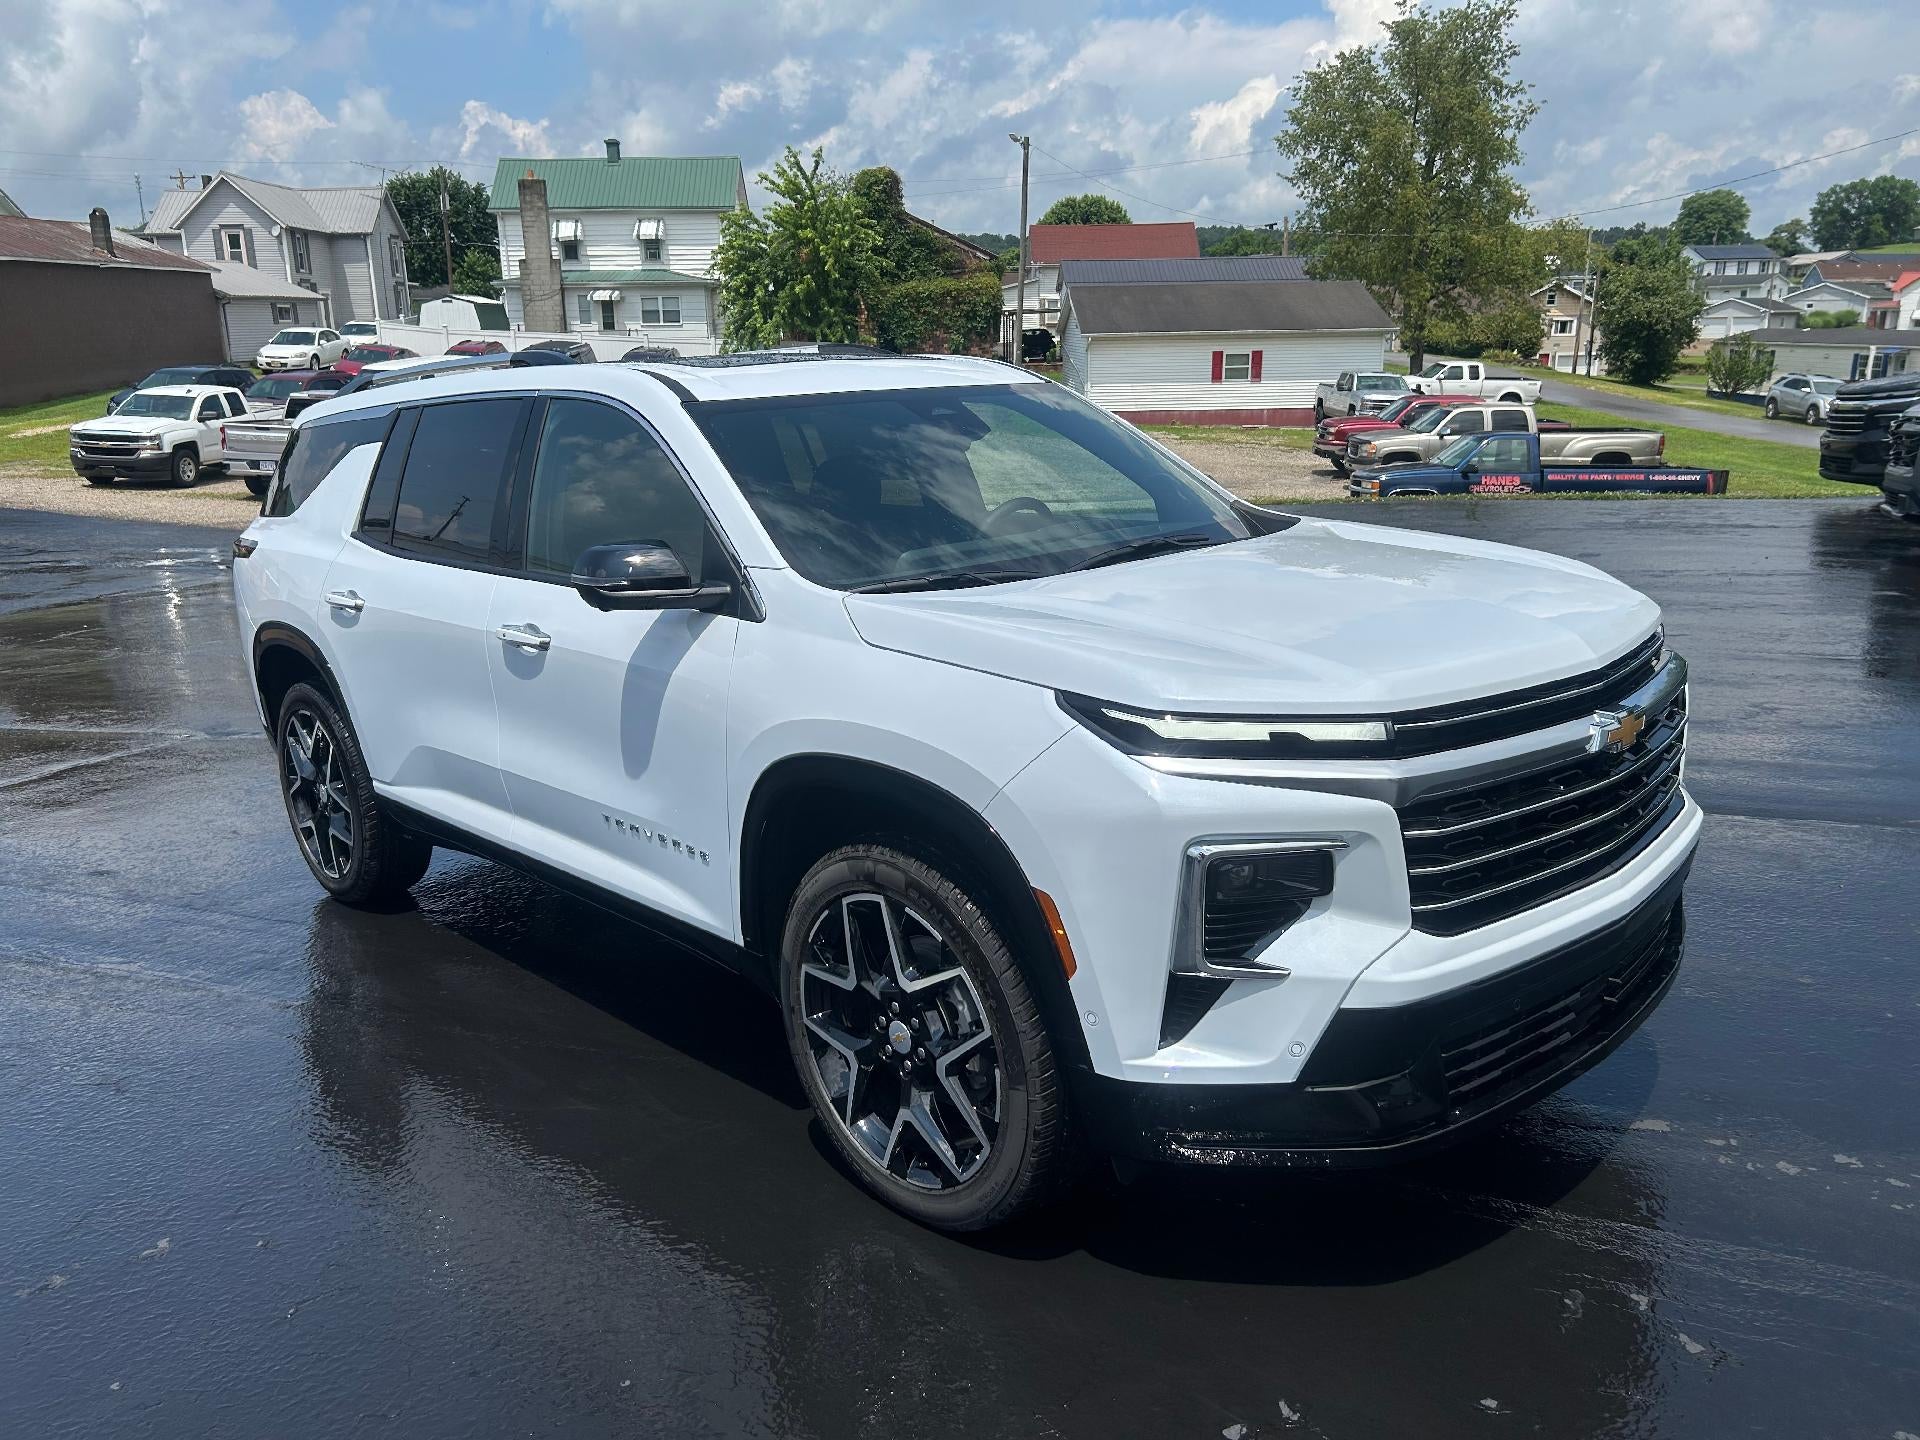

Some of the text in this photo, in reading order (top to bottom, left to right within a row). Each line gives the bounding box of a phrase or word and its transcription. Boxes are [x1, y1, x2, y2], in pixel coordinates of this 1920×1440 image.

[1482, 475, 1520, 486] HANES
[1469, 484, 1513, 493] CHEVROLET
[601, 813, 710, 862] TRAVERSE
